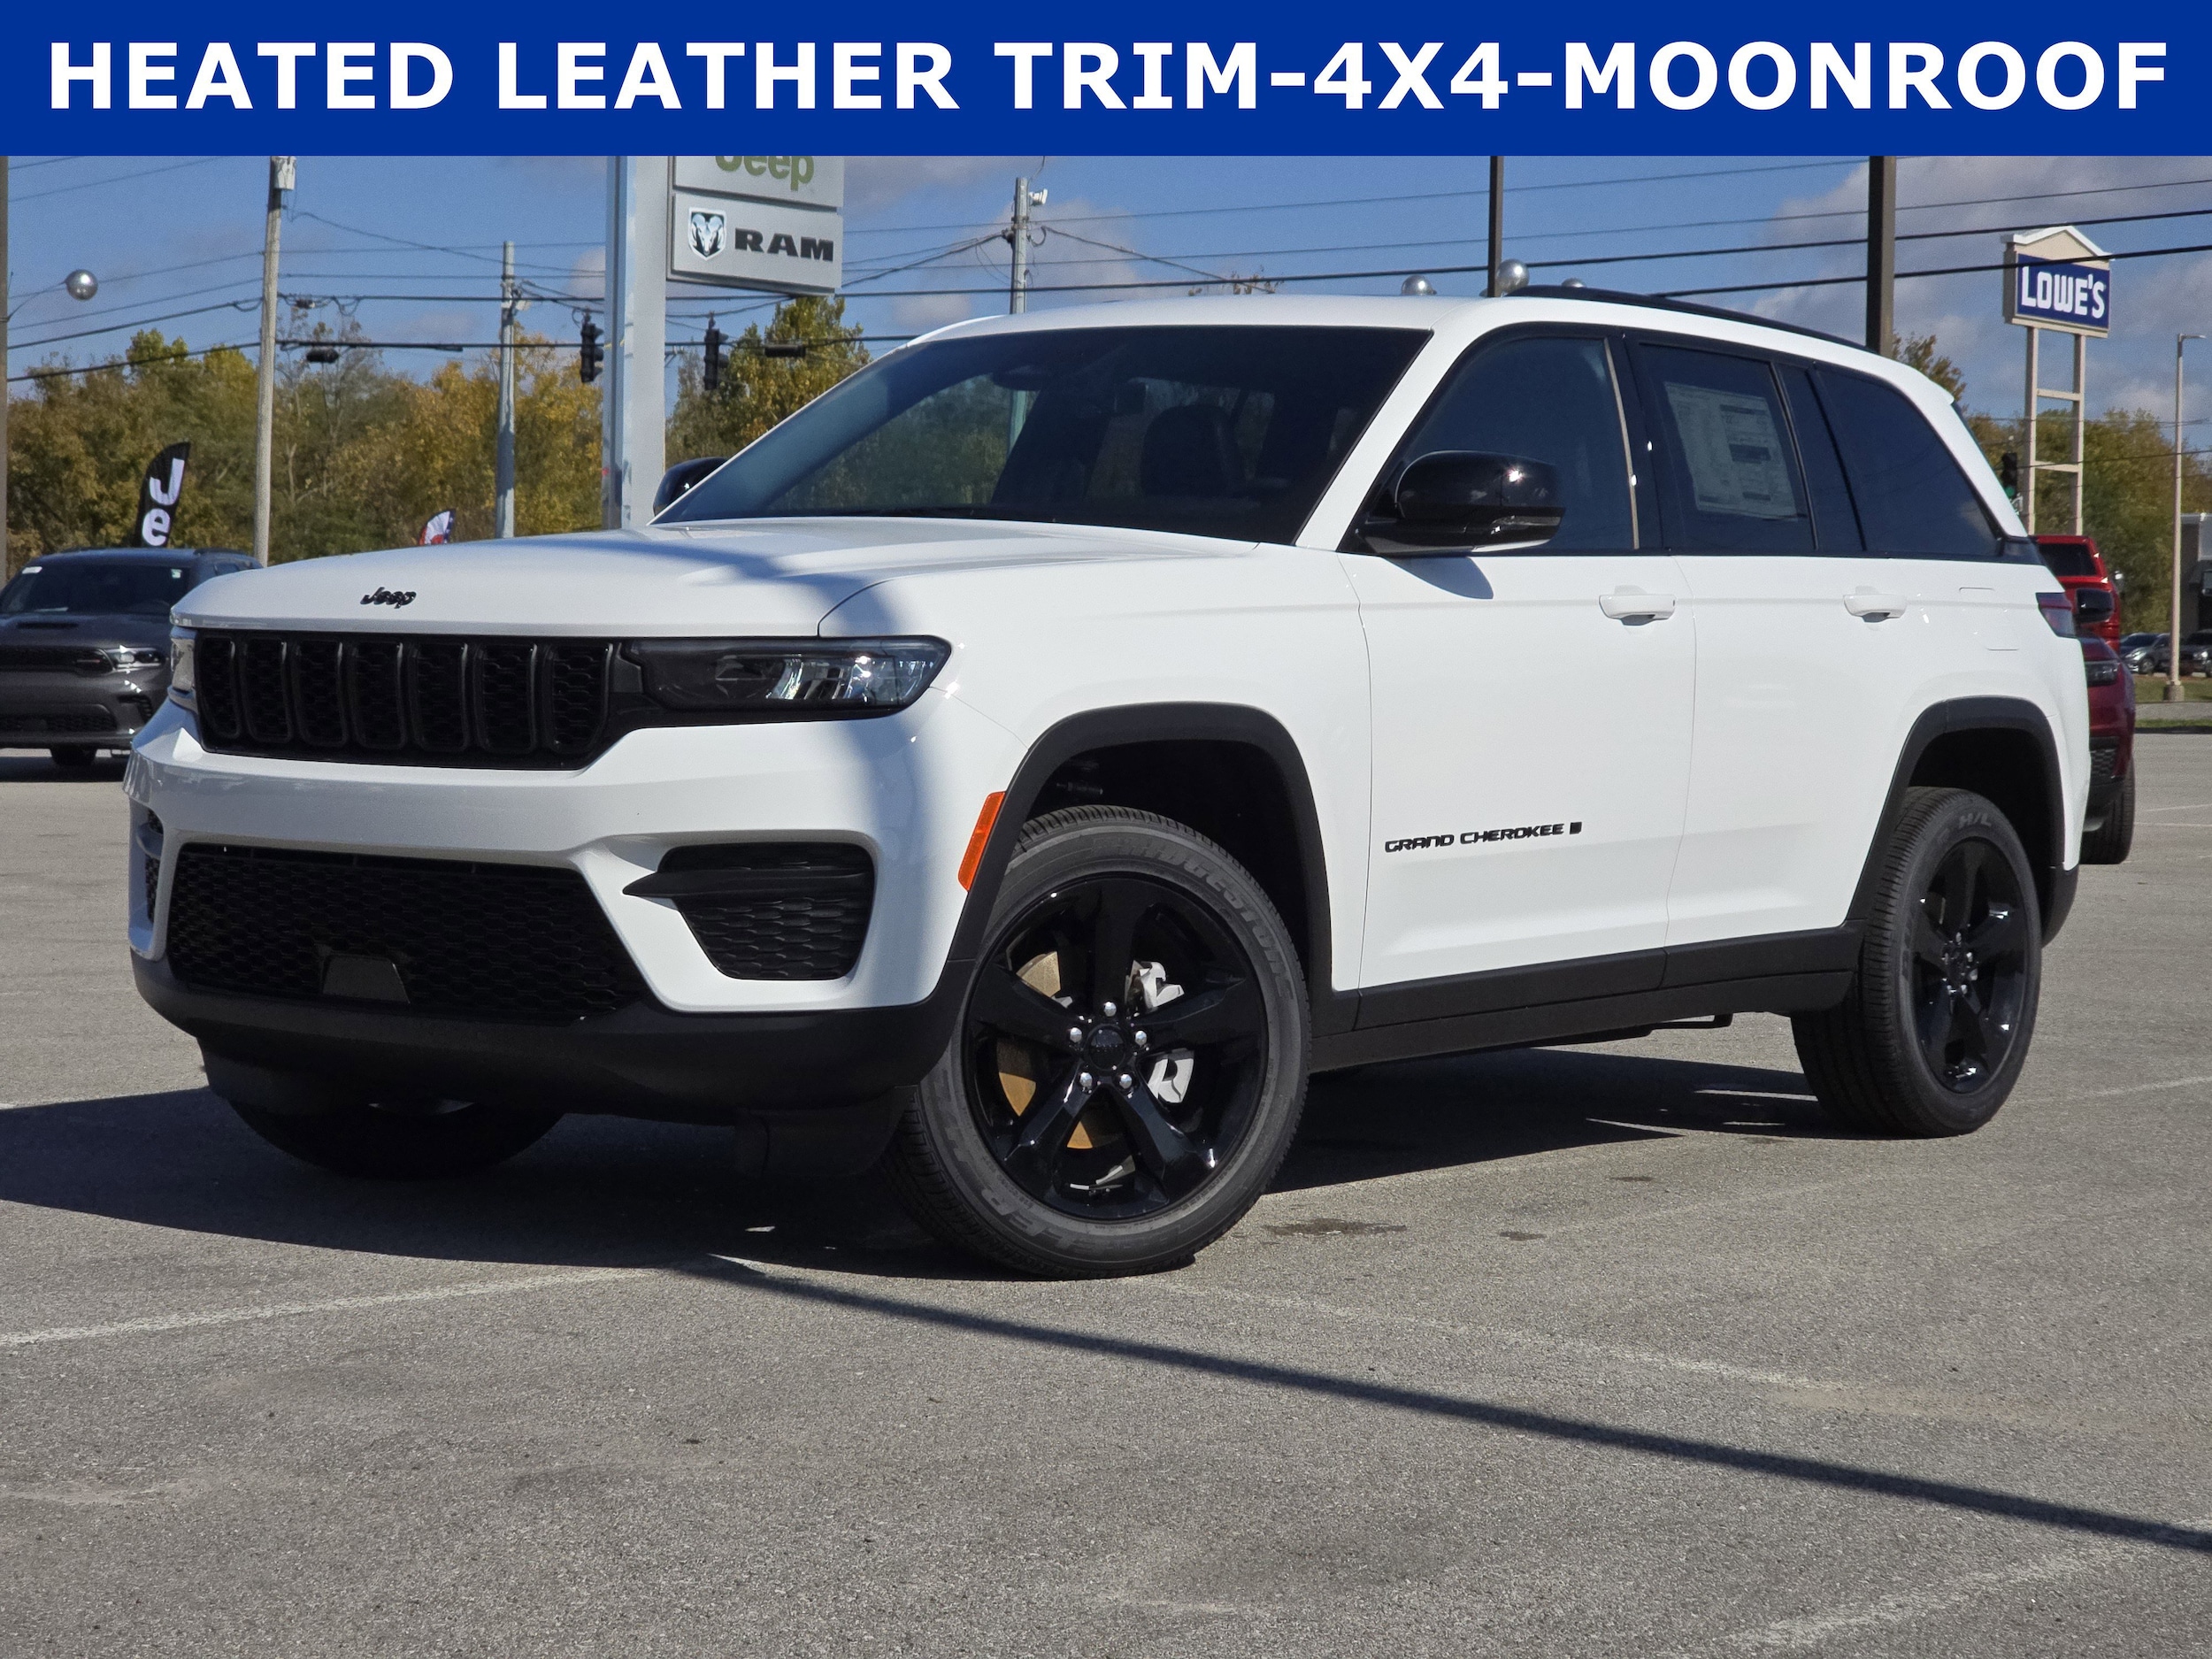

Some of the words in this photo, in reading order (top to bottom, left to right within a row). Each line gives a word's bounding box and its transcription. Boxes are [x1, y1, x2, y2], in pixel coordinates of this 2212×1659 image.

[734, 227, 834, 262] RAM
[2021, 265, 2106, 319] LOWE'S
[359, 586, 417, 610] Jeep
[1384, 833, 1455, 853] GRAND
[1459, 823, 1565, 845] CHEROKEE
